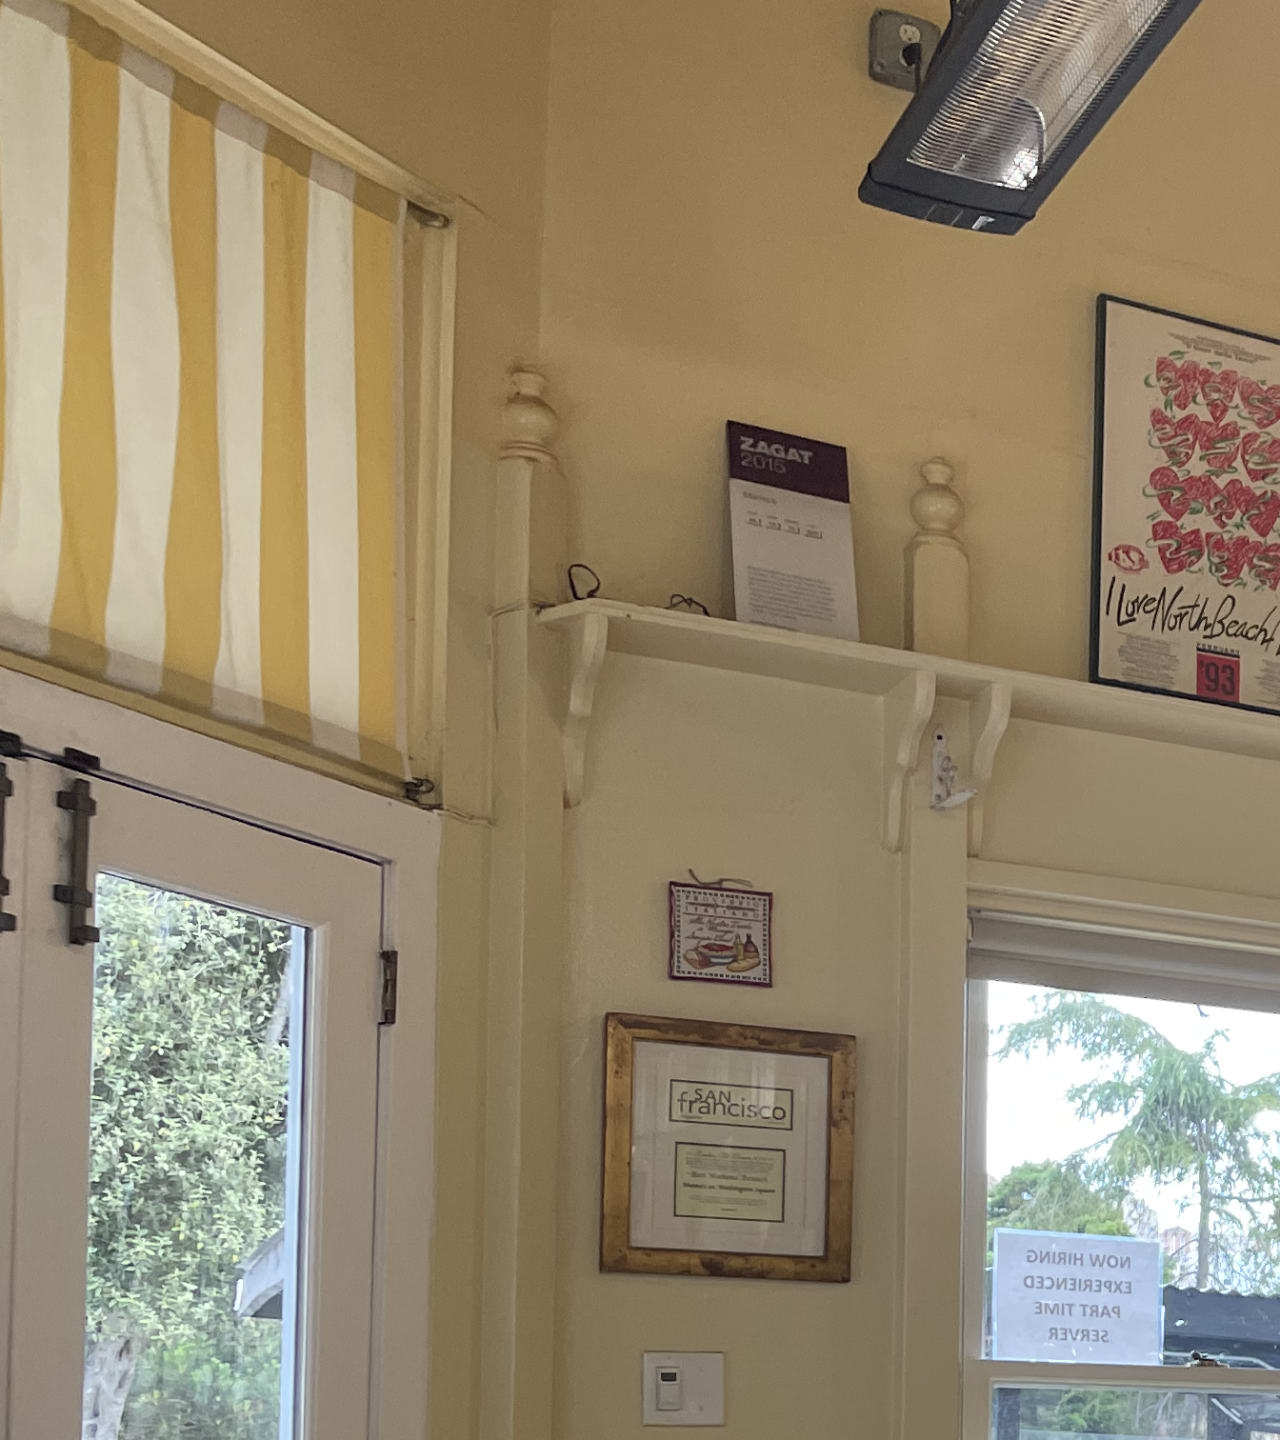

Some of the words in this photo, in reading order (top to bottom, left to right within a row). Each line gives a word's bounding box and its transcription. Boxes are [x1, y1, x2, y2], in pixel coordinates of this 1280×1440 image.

[740, 435, 813, 465] ZAGAT
[1105, 576, 1116, 616] I
[1117, 583, 1156, 627] Love
[1150, 585, 1212, 634] North
[1202, 594, 1275, 647] Beach
[676, 1090, 787, 1121] francisco
[694, 1087, 731, 1104] SAN
